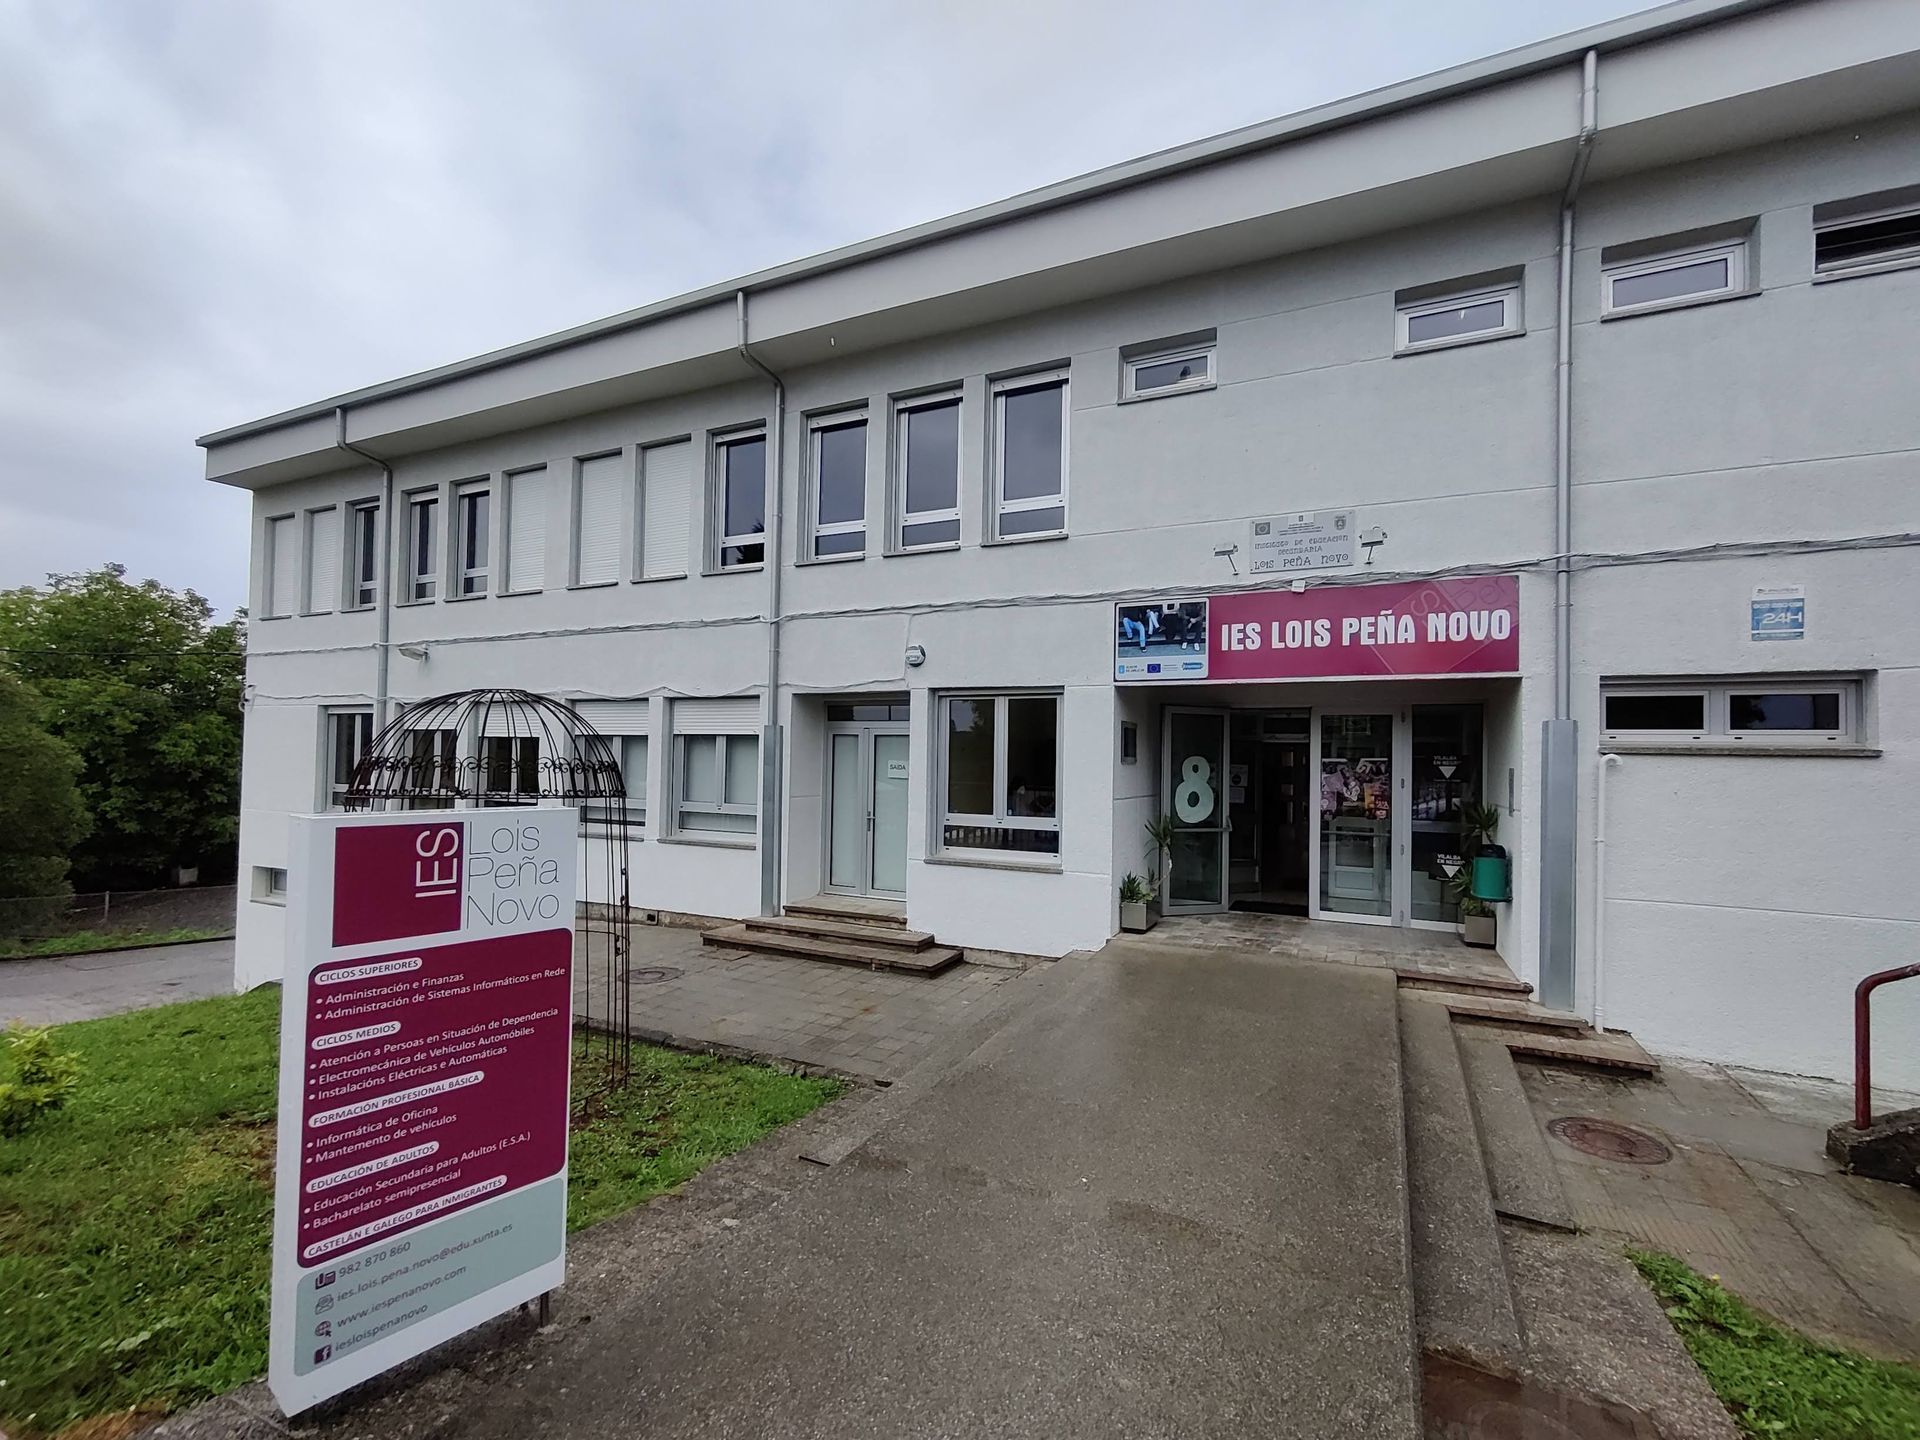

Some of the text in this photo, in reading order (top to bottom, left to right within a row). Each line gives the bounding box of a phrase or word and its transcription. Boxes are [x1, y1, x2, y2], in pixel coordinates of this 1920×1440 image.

[1221, 609, 1511, 651] IES LOIS PEÑA NOVO
[1174, 755, 1215, 824] 8
[469, 820, 540, 855] Lois
[415, 828, 459, 898] IES
[468, 856, 559, 892] Peña
[466, 892, 560, 930] Novo
[320, 960, 418, 982] CICLOS SUPERIORES
[324, 968, 566, 1020] Administración de Sistemas Informáticos en Rede
[325, 982, 410, 1004] Administración
[422, 973, 464, 987] Finanzas
[316, 1024, 396, 1047] CICLOS MEDIOS
[319, 1050, 371, 1069] Atención
[384, 1038, 424, 1053] Persoas
[426, 1034, 439, 1044] en
[442, 1024, 485, 1040] Situación
[488, 1020, 500, 1030] de
[502, 1008, 558, 1026] Dependencia
[319, 1026, 535, 1085] Electromecánica de Vehículos Automóbiles
[318, 1076, 386, 1100] Instalacións
[388, 1063, 438, 1082] Eléctricas
[448, 1046, 507, 1067] Automáticas
[313, 1074, 479, 1126] FORMACIÓN PROFESIONAL BÁSICA
[315, 1114, 457, 1163] Mantemento de vehículos
[316, 1106, 438, 1148] Informática de Oficina
[311, 1144, 435, 1191] EDUCACIÓN DE ADULTOS
[314, 1185, 372, 1212] Educación
[436, 1157, 458, 1172] para
[460, 1144, 496, 1161] Adultos
[499, 1131, 531, 1150] (E.S.A.)
[308, 1178, 502, 1256] CASTELÁN E GALEGO PARA INMIGRANTES
[313, 1168, 461, 1228] Bacharelato semipresencial
[339, 1241, 410, 1278] 982 870 860
[337, 1265, 466, 1328] www.iespenanovo.com
[335, 1304, 428, 1351] iesloispenanovo
